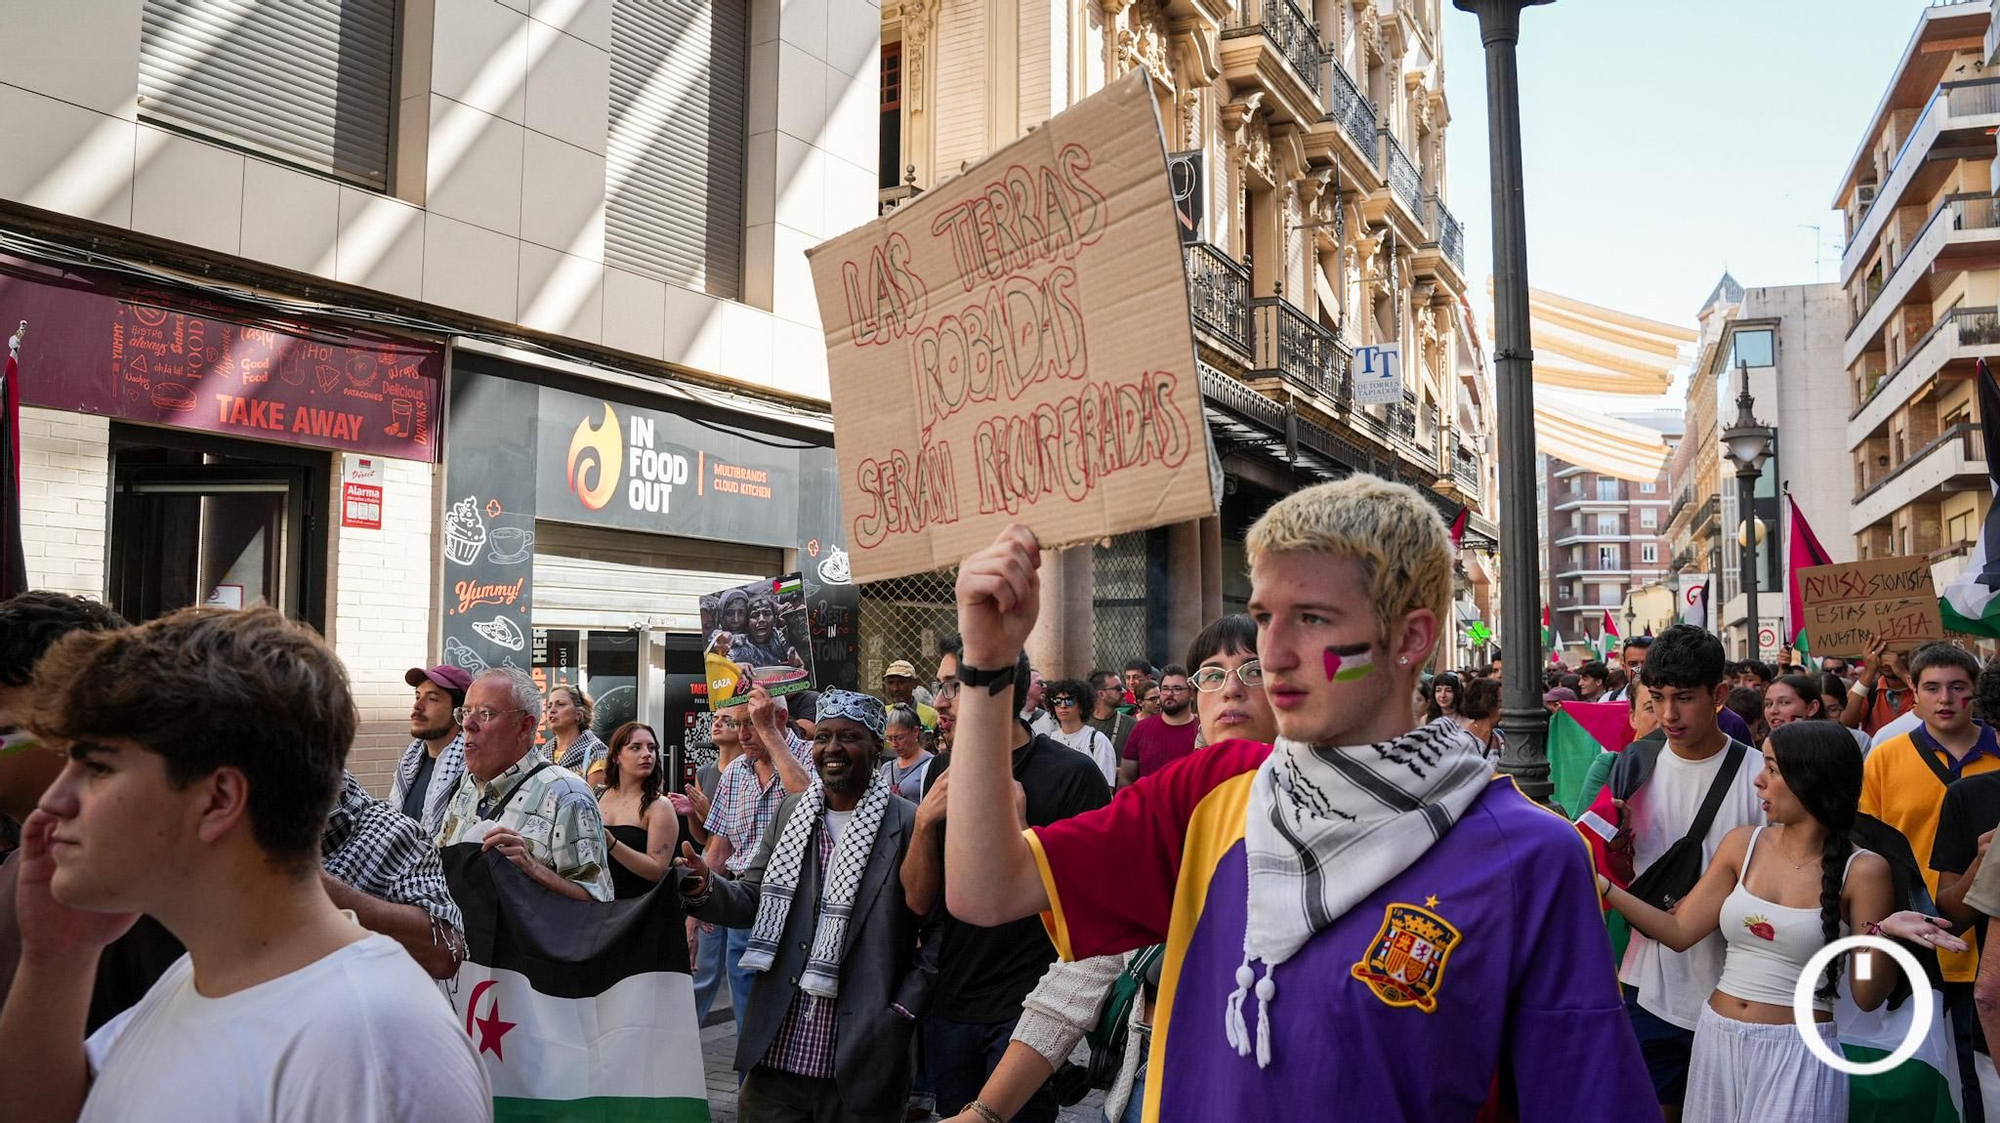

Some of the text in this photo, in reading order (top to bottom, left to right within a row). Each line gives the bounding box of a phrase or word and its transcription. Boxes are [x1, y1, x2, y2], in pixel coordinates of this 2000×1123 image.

[843, 142, 1108, 347] LAS TIERRAS
[112, 322, 124, 360] YUMMY
[131, 325, 163, 340] BISTRO
[129, 336, 169, 356] always
[187, 320, 204, 379] FOOD
[912, 266, 1088, 432] ROBADAS
[241, 357, 270, 371] Good
[388, 363, 420, 380] Wraps
[242, 371, 269, 385] Food
[382, 380, 424, 400] Delicious
[343, 387, 383, 402] PATACONES
[215, 393, 364, 442] TAKE AWAY
[414, 401, 427, 446] DRINKS
[630, 415, 654, 449] IN
[629, 447, 689, 486] FOOD
[713, 463, 767, 484] MULTIBRANDS
[347, 485, 380, 498] Alarma
[628, 478, 673, 514] OUT
[713, 478, 771, 500] CLOUD KITCHEN
[853, 426, 959, 550] SERÁN
[455, 577, 524, 614] Yummy!
[1804, 566, 1934, 602] AYUSO SIONISTA
[817, 600, 848, 626] BEST
[1815, 601, 1892, 624] ESTAS EN
[1878, 611, 1933, 638] LISTA
[827, 623, 837, 638] IN
[532, 629, 548, 663] HER
[815, 638, 847, 661] TOWN
[712, 677, 732, 690] GAZA
